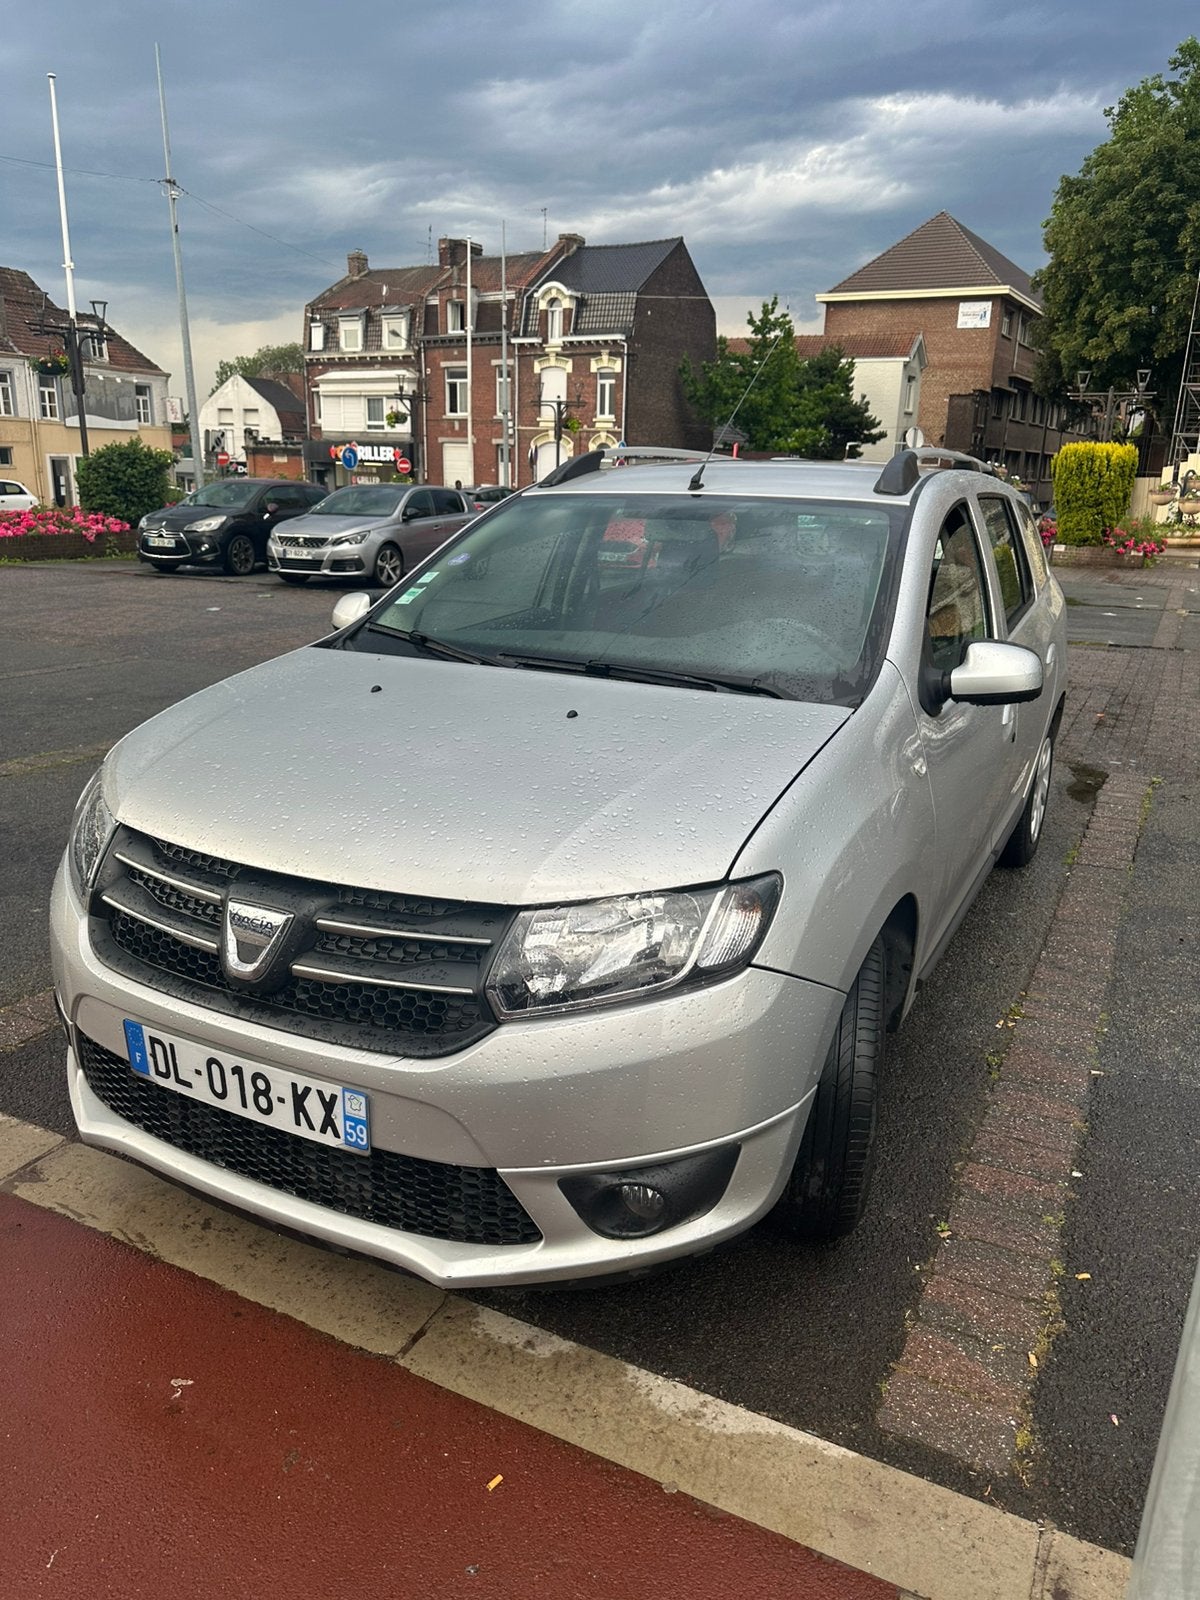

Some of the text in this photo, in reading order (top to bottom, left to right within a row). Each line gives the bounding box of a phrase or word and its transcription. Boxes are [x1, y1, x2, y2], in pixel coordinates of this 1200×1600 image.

[135, 1052, 142, 1063] F
[149, 1035, 341, 1139] DL-018-KX
[345, 1120, 367, 1145] 59
